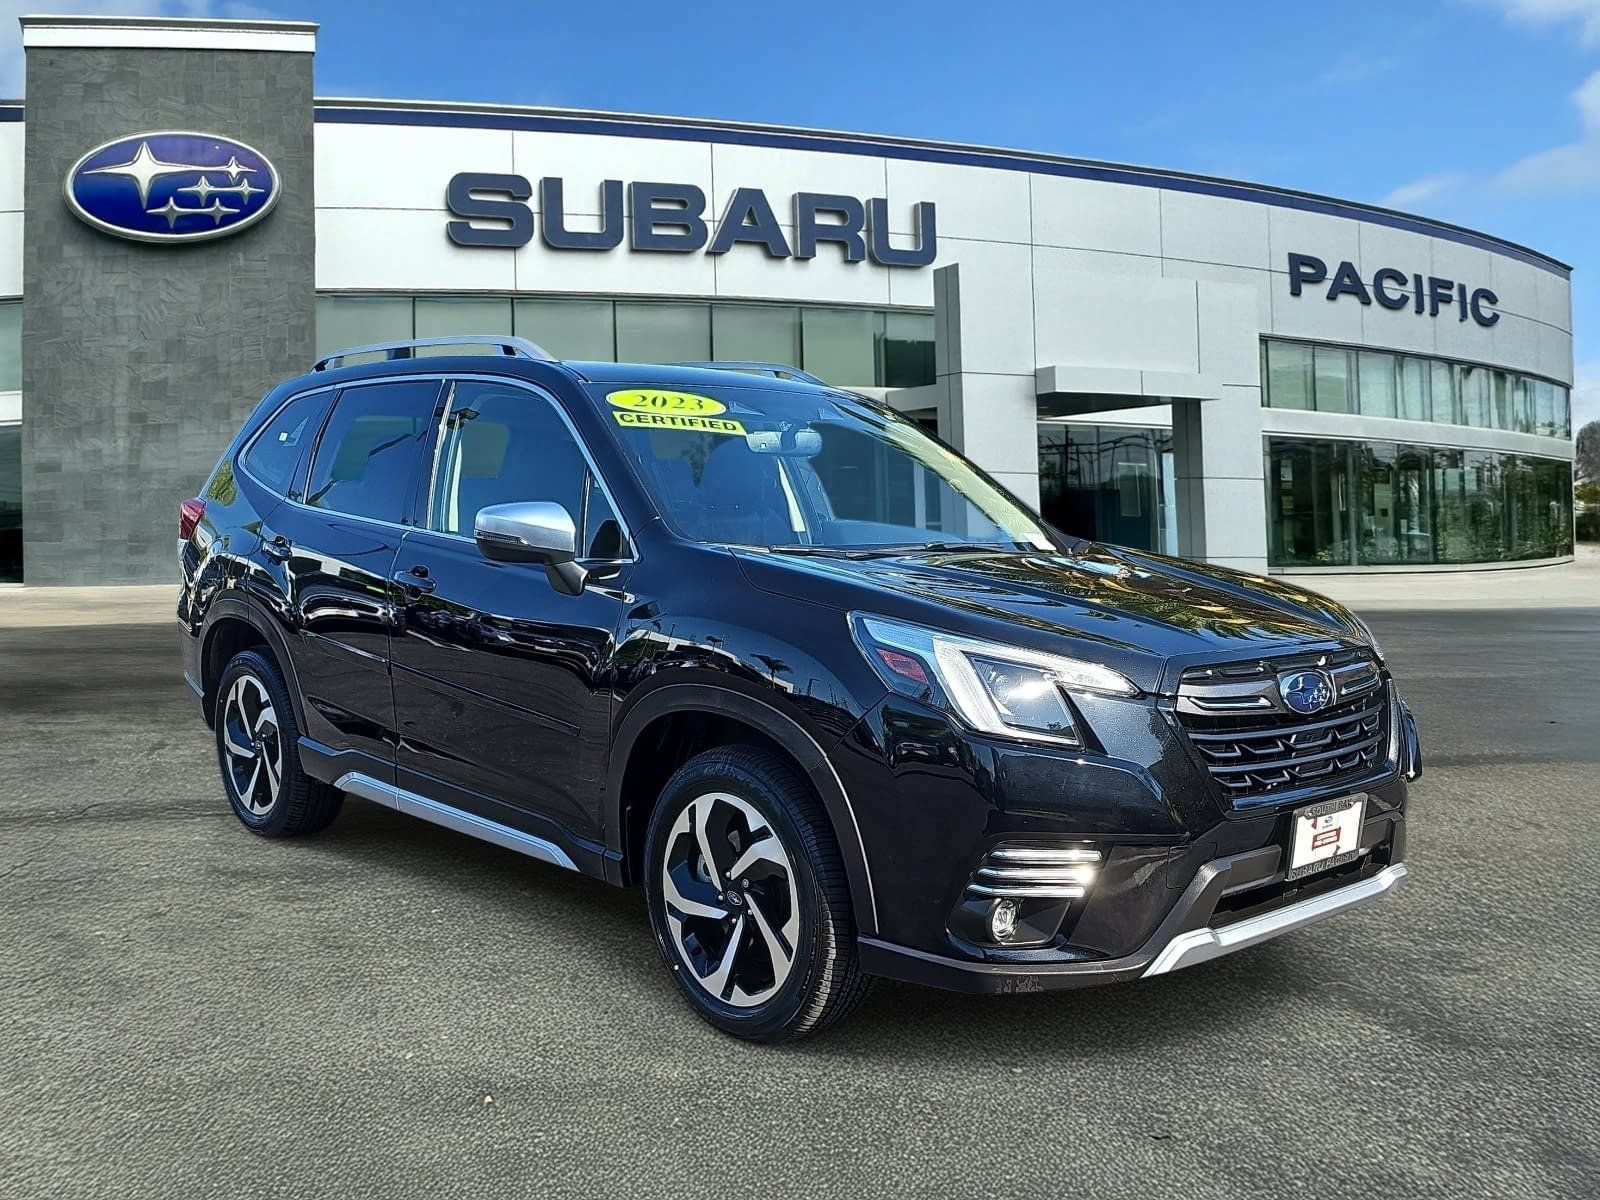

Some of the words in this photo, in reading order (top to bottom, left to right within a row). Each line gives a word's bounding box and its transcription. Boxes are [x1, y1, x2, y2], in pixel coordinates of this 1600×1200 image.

[446, 172, 937, 267] SUBARU
[1288, 252, 1500, 327] PACIFIC
[620, 413, 737, 431] CERTIFIED
[632, 395, 704, 410] 2023
